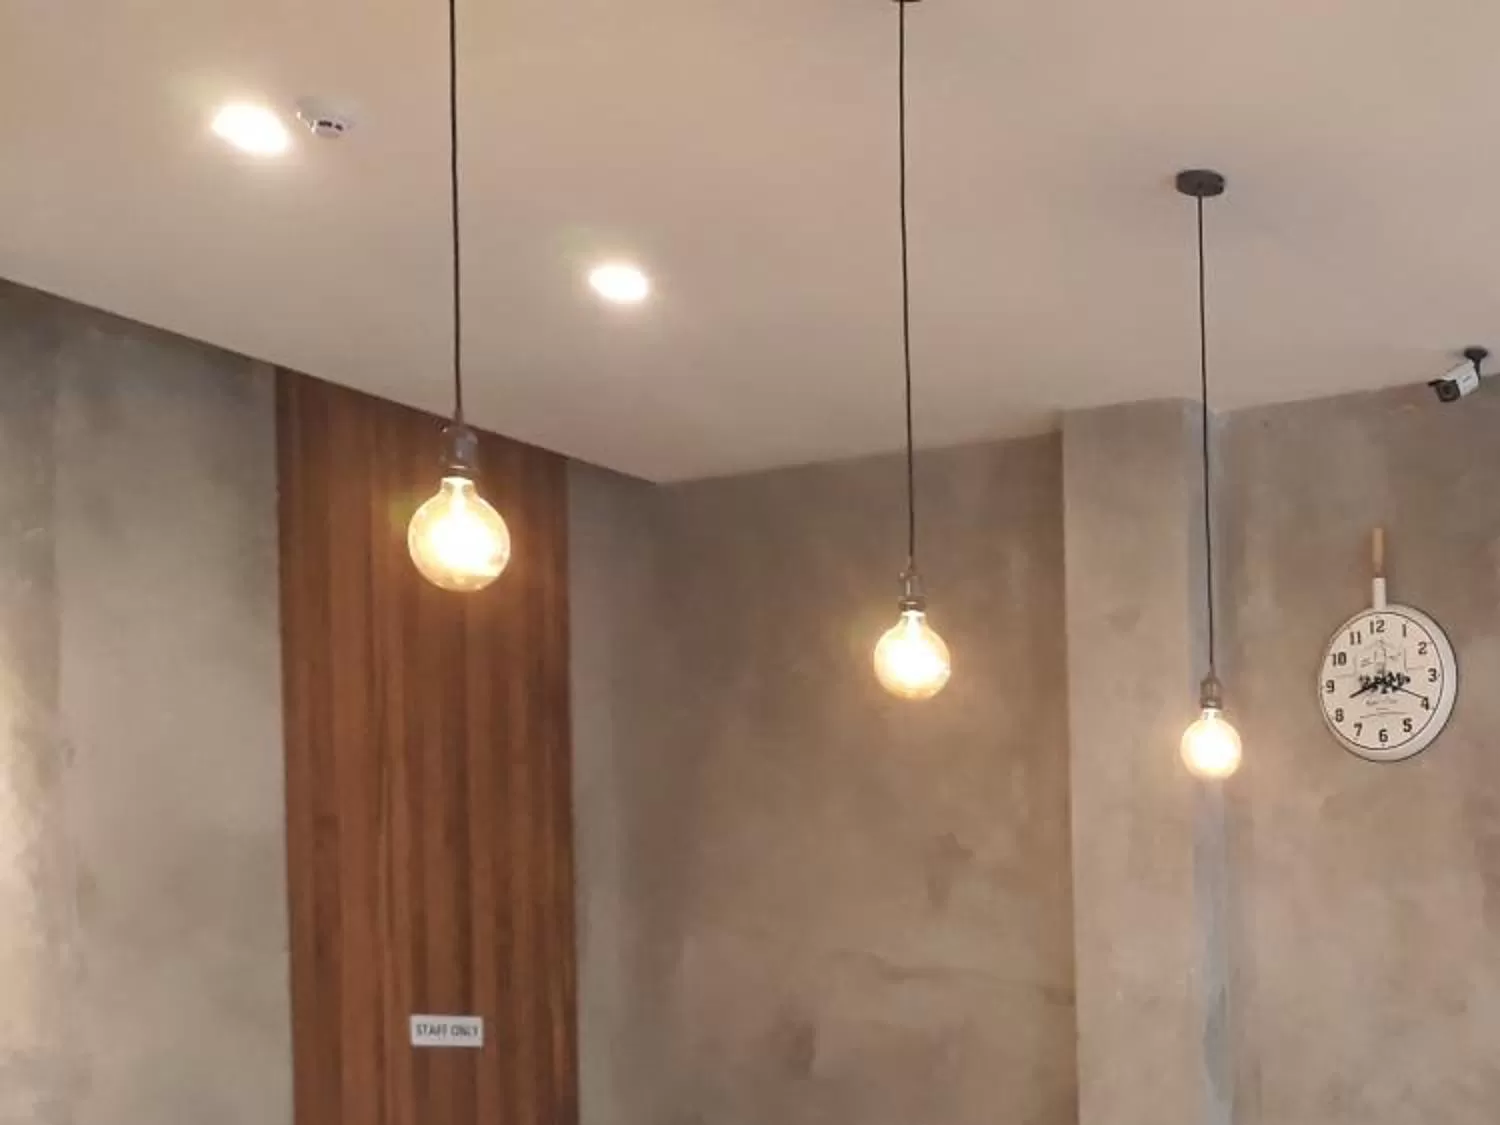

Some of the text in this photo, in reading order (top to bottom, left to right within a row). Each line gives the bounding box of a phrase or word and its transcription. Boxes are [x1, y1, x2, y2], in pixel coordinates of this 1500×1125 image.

[1369, 619, 1385, 634] 12
[1350, 631, 1362, 645] 11
[1418, 641, 1427, 655] 2
[1332, 651, 1347, 666] 10
[1428, 668, 1437, 682] 3
[1326, 679, 1335, 693] 9
[1420, 697, 1429, 710] 4
[1336, 708, 1344, 722] 8
[1353, 723, 1363, 736] 7
[1403, 718, 1412, 732] 5
[1379, 729, 1388, 742] 6
[416, 1023, 479, 1037] STAFF ONLY
